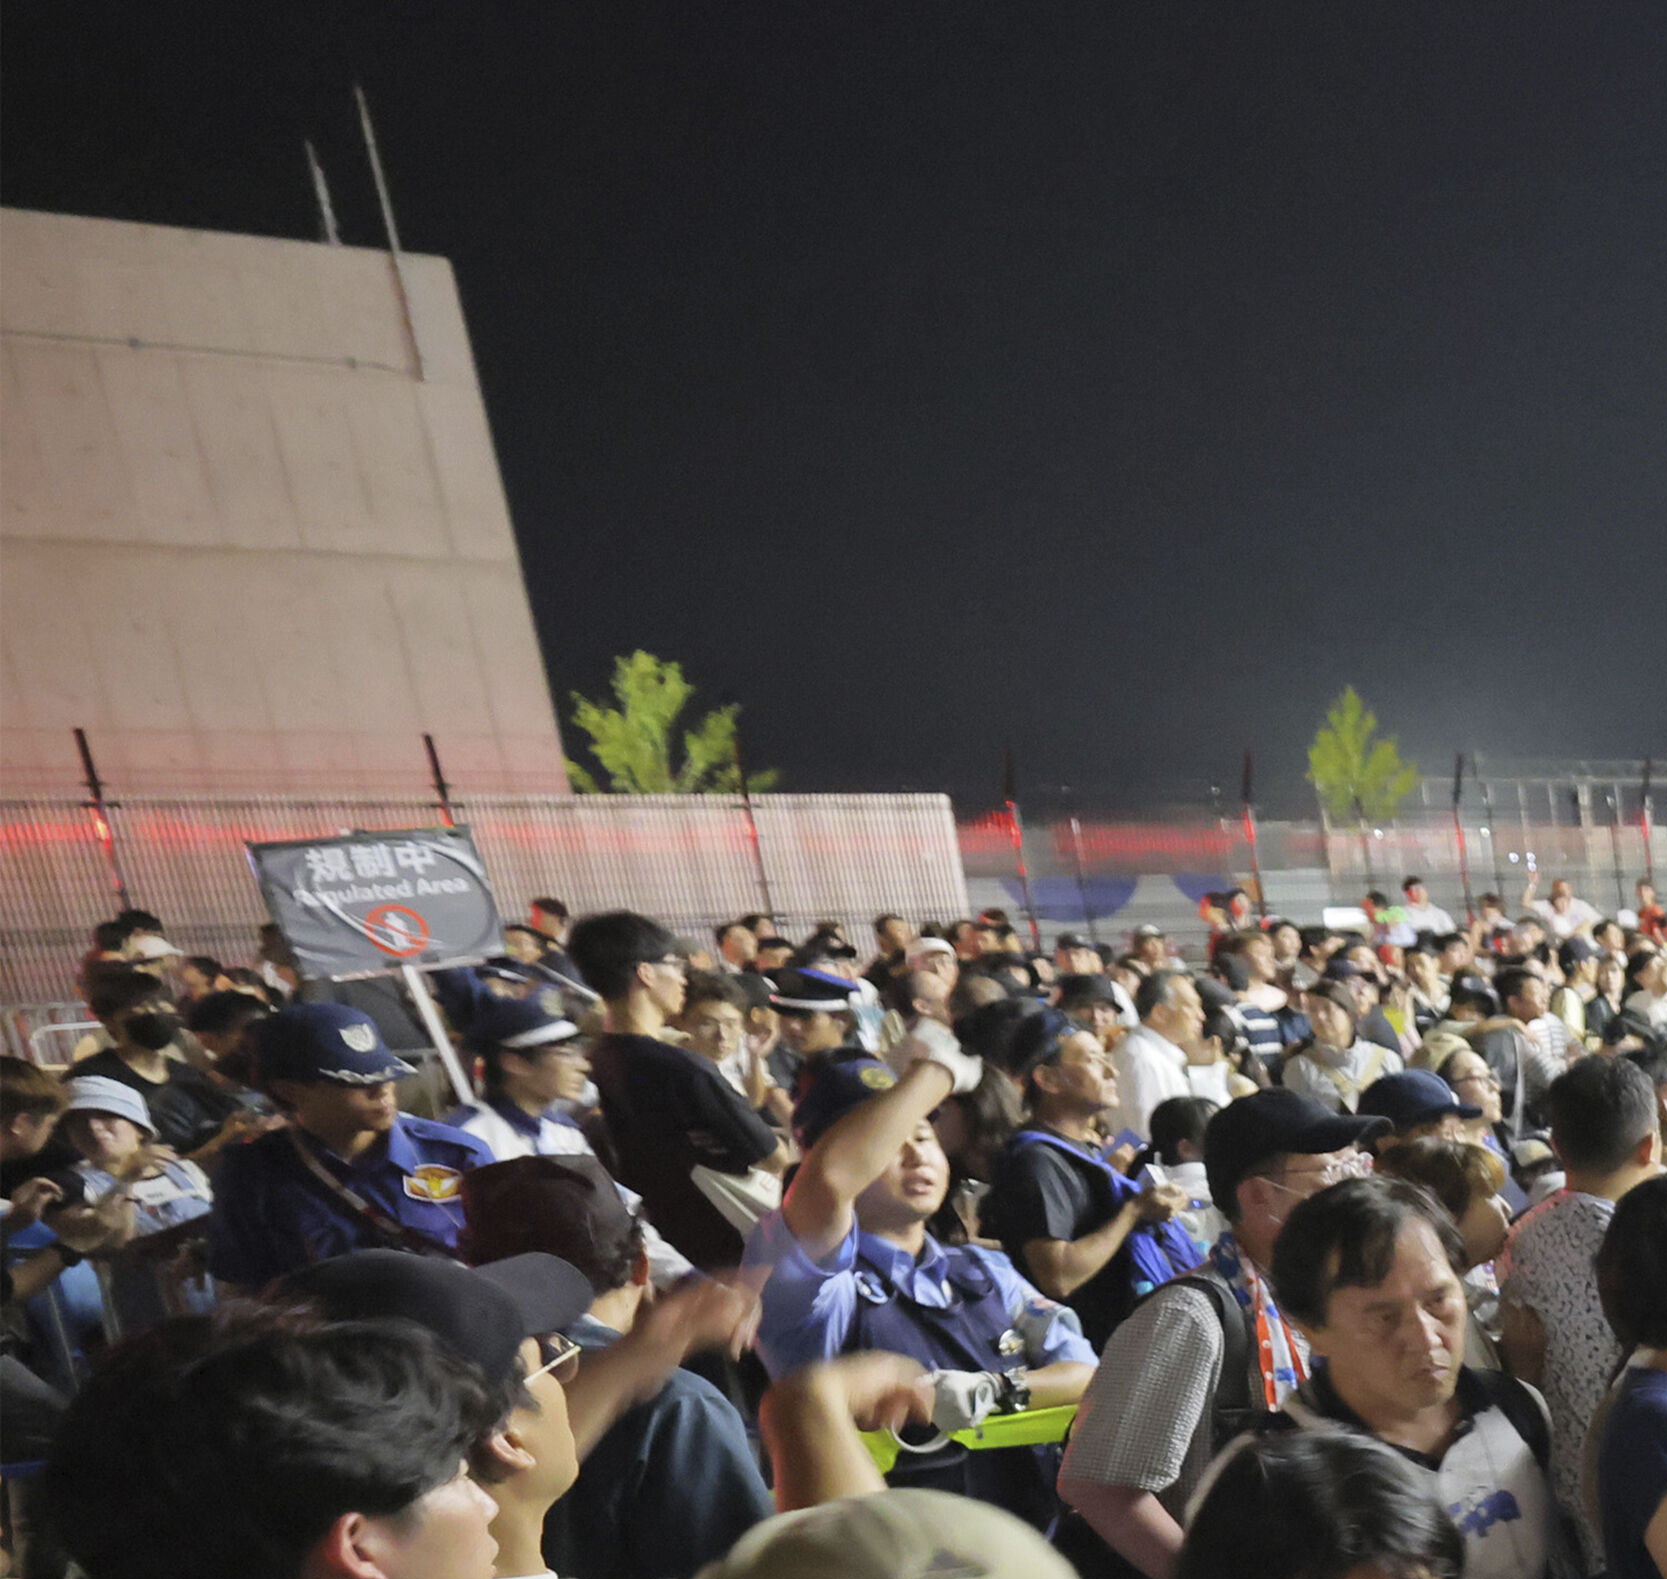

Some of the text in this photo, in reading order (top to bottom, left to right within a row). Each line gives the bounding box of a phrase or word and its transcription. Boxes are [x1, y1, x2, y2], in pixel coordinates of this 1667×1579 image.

[305, 841, 436, 882] 規制中
[294, 876, 471, 907] gulated Area
